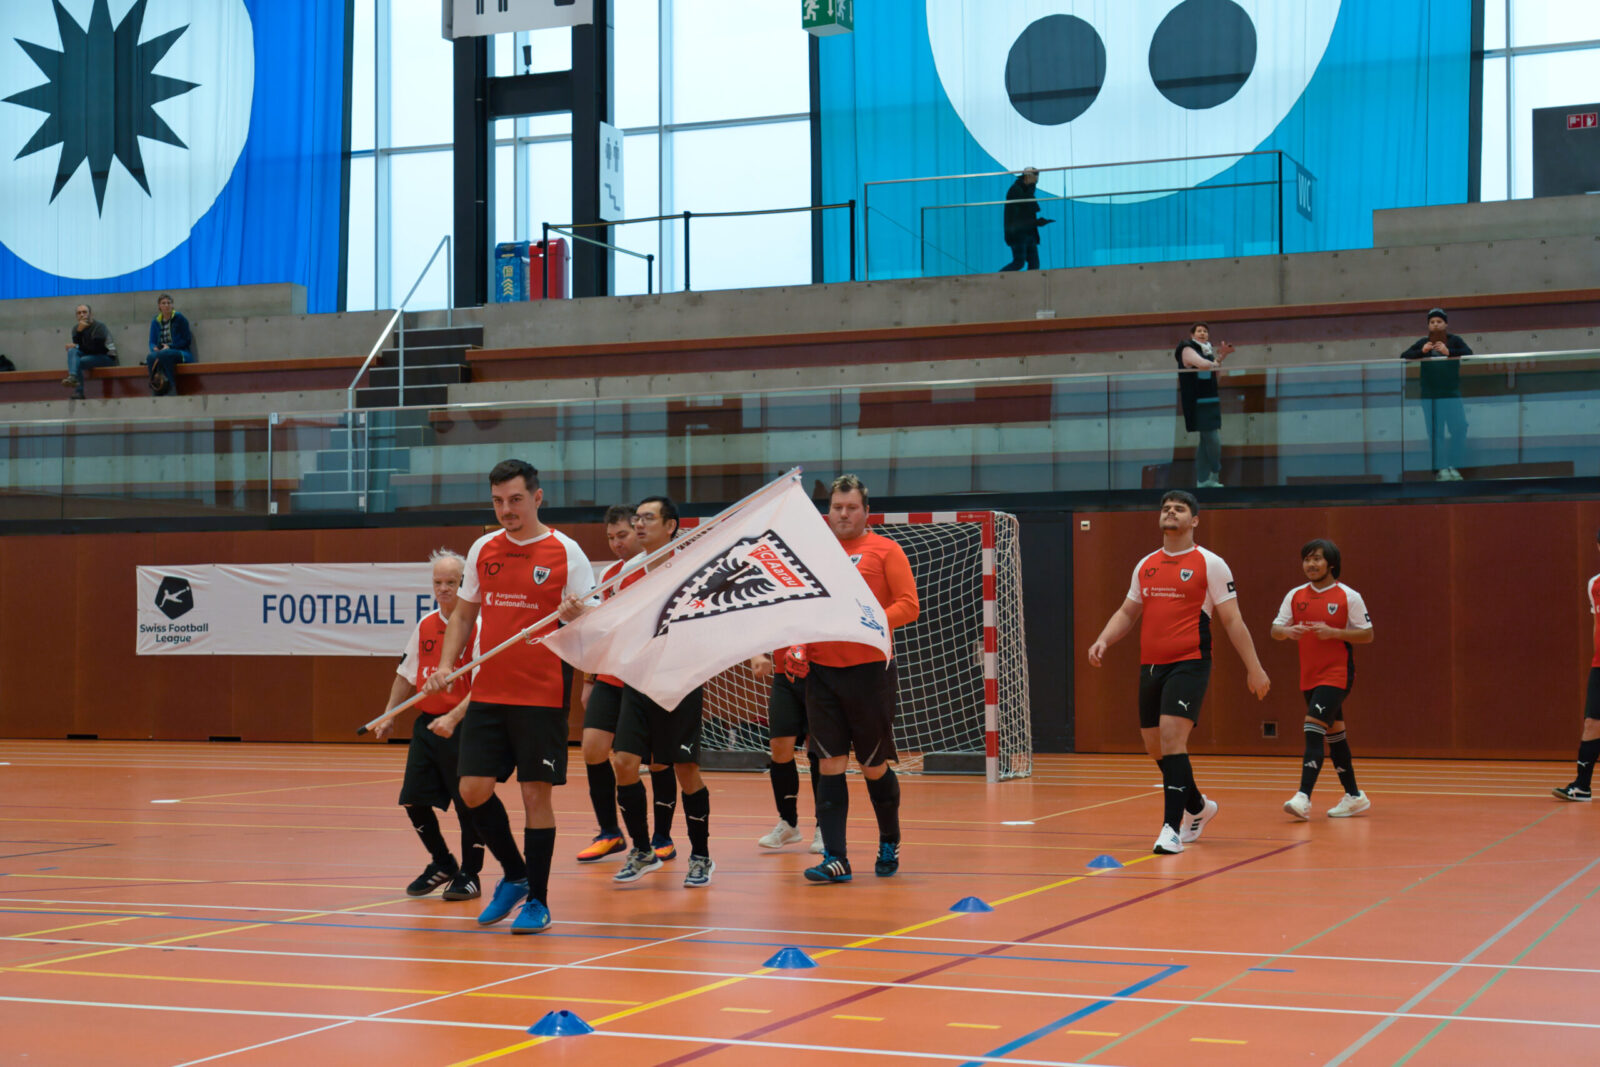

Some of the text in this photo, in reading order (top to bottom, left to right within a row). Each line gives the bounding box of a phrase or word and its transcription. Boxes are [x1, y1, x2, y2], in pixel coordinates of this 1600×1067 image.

[1298, 172, 1311, 212] WC
[766, 560, 799, 586] Aarau
[262, 593, 405, 625] FOOTBALL
[494, 600, 540, 610] Kantonalbank
[139, 622, 209, 633] Swiss Football
[155, 634, 192, 645] League
